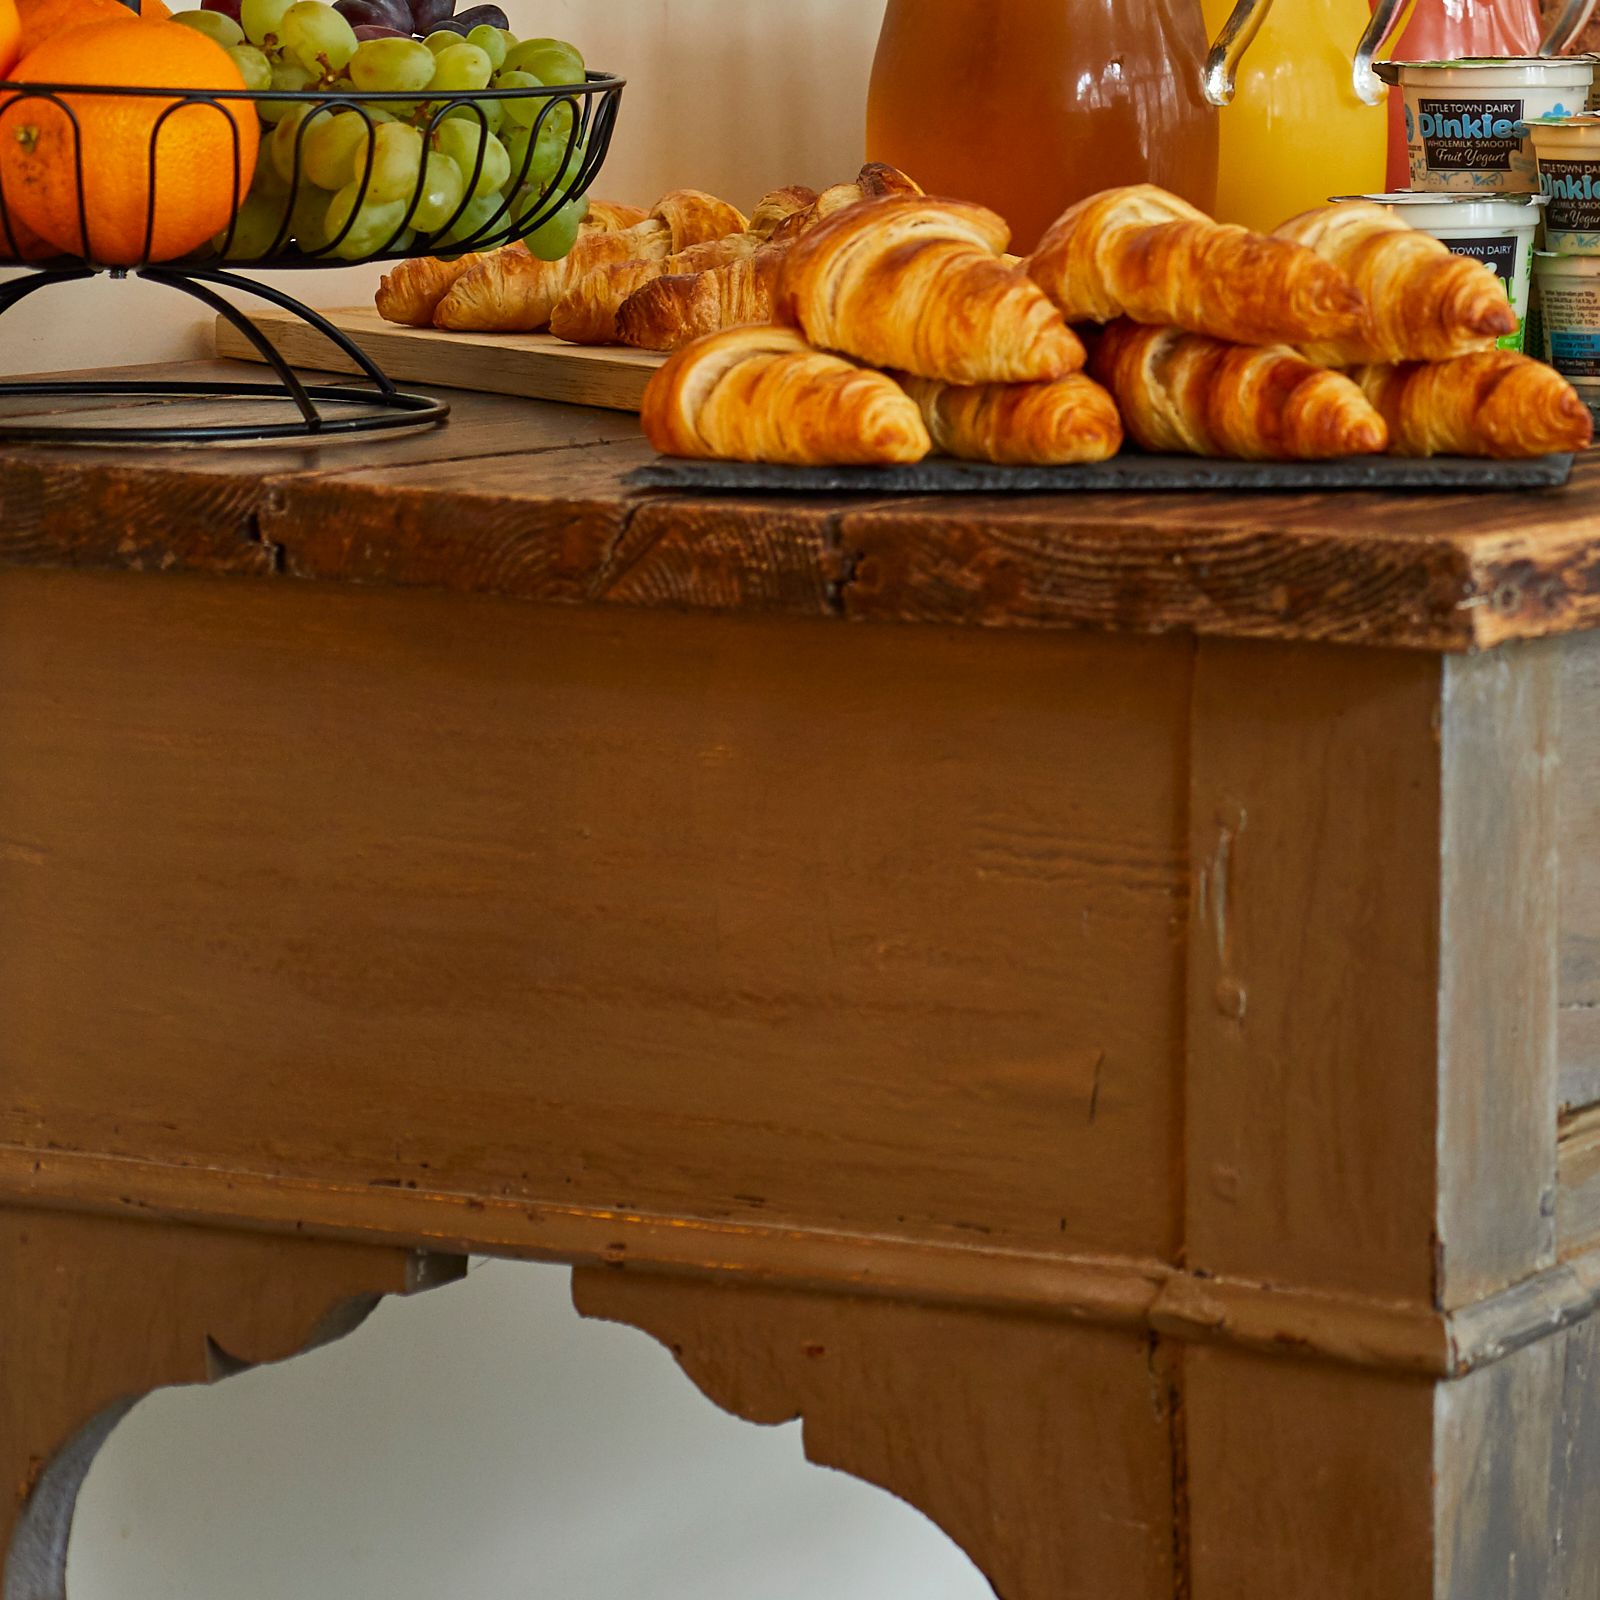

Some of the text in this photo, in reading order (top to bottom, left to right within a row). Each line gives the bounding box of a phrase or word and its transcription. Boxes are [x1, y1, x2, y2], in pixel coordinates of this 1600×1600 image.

[1424, 103, 1516, 113] LITTLE TOWN DAIRY
[1418, 112, 1530, 139] Dinkies
[1427, 140, 1517, 148] WHOLEMILK SMOOTH
[1436, 148, 1462, 162] Fruit
[1464, 148, 1505, 167] Yogurt
[1557, 164, 1582, 173] TOWN
[1451, 245, 1512, 255] TOWN DAIRY
